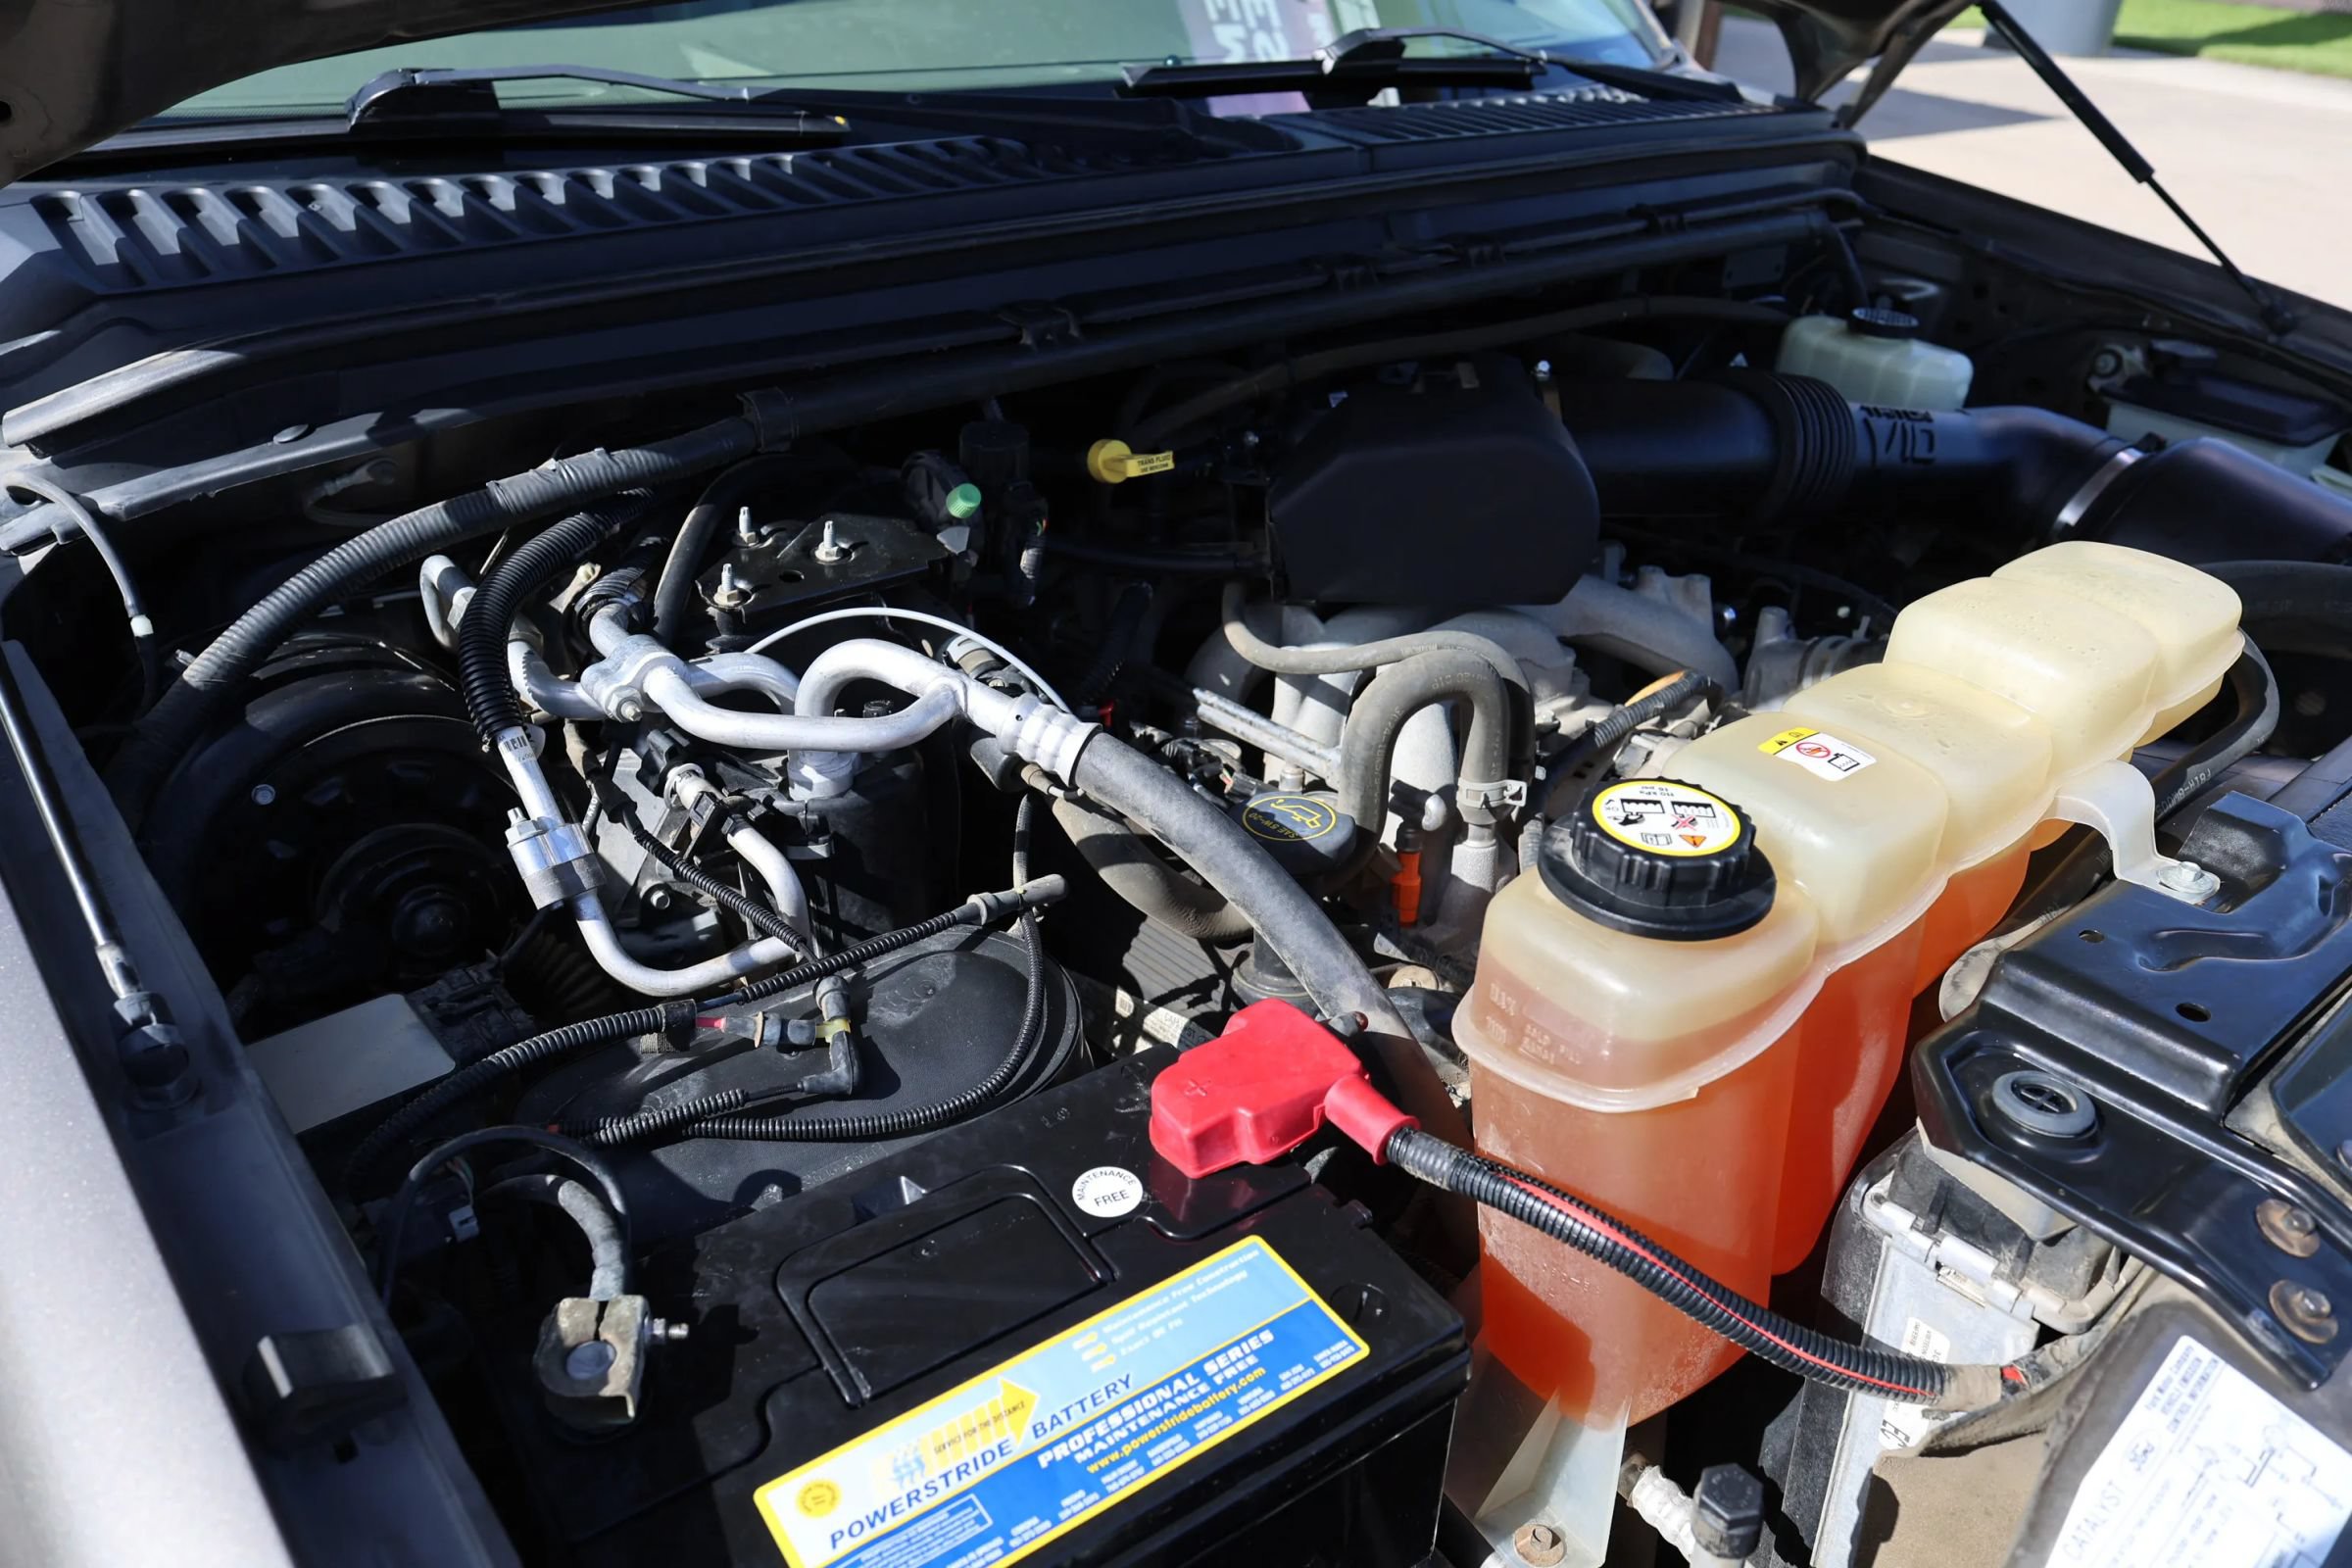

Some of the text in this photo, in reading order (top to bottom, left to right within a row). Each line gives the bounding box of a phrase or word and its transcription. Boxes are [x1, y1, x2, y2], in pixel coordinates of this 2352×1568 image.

[1249, 812, 1299, 839] SAE 5W-20
[1076, 1169, 1137, 1201] MAINTENANCE
[1094, 1189, 1130, 1207] FREE
[962, 1426, 979, 1442] FOR
[992, 1400, 1026, 1429] DISTANCE
[1037, 1372, 1200, 1469] PROFESSIONAL
[1202, 1329, 1275, 1377] SERIES
[1074, 1382, 1210, 1464] MAINTENANCE
[1212, 1354, 1259, 1386] FREE
[1086, 1366, 1266, 1474] www.powerstridebattery.com
[829, 1438, 1014, 1549] POWERSTRIDE
[1032, 1374, 1132, 1441] BATTERY
[2062, 1480, 2127, 1561] CATALYST
